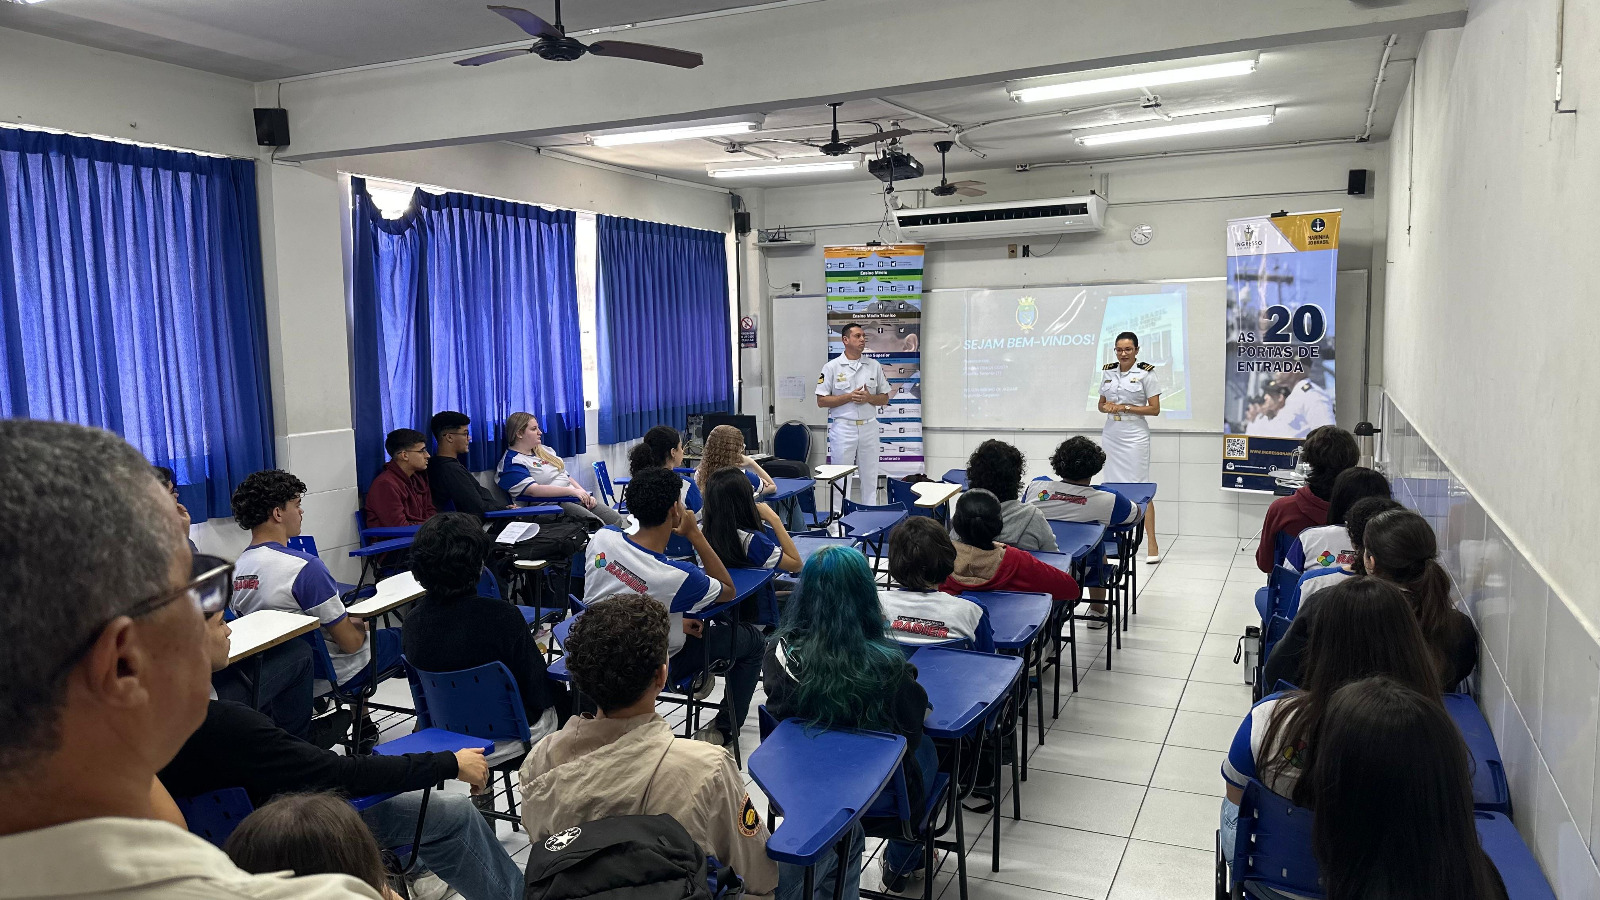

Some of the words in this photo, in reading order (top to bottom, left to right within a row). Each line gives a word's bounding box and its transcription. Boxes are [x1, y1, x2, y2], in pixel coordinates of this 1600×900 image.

[1238, 332, 1255, 343] AS
[1262, 303, 1327, 344] 20
[963, 338, 1005, 350] SEJAM
[1007, 334, 1096, 349] BEM-VINDOS!
[1237, 346, 1293, 358] PORTAS
[1298, 346, 1320, 358] DE
[1237, 361, 1304, 373] ENTRADA
[891, 620, 949, 638] RADIER
